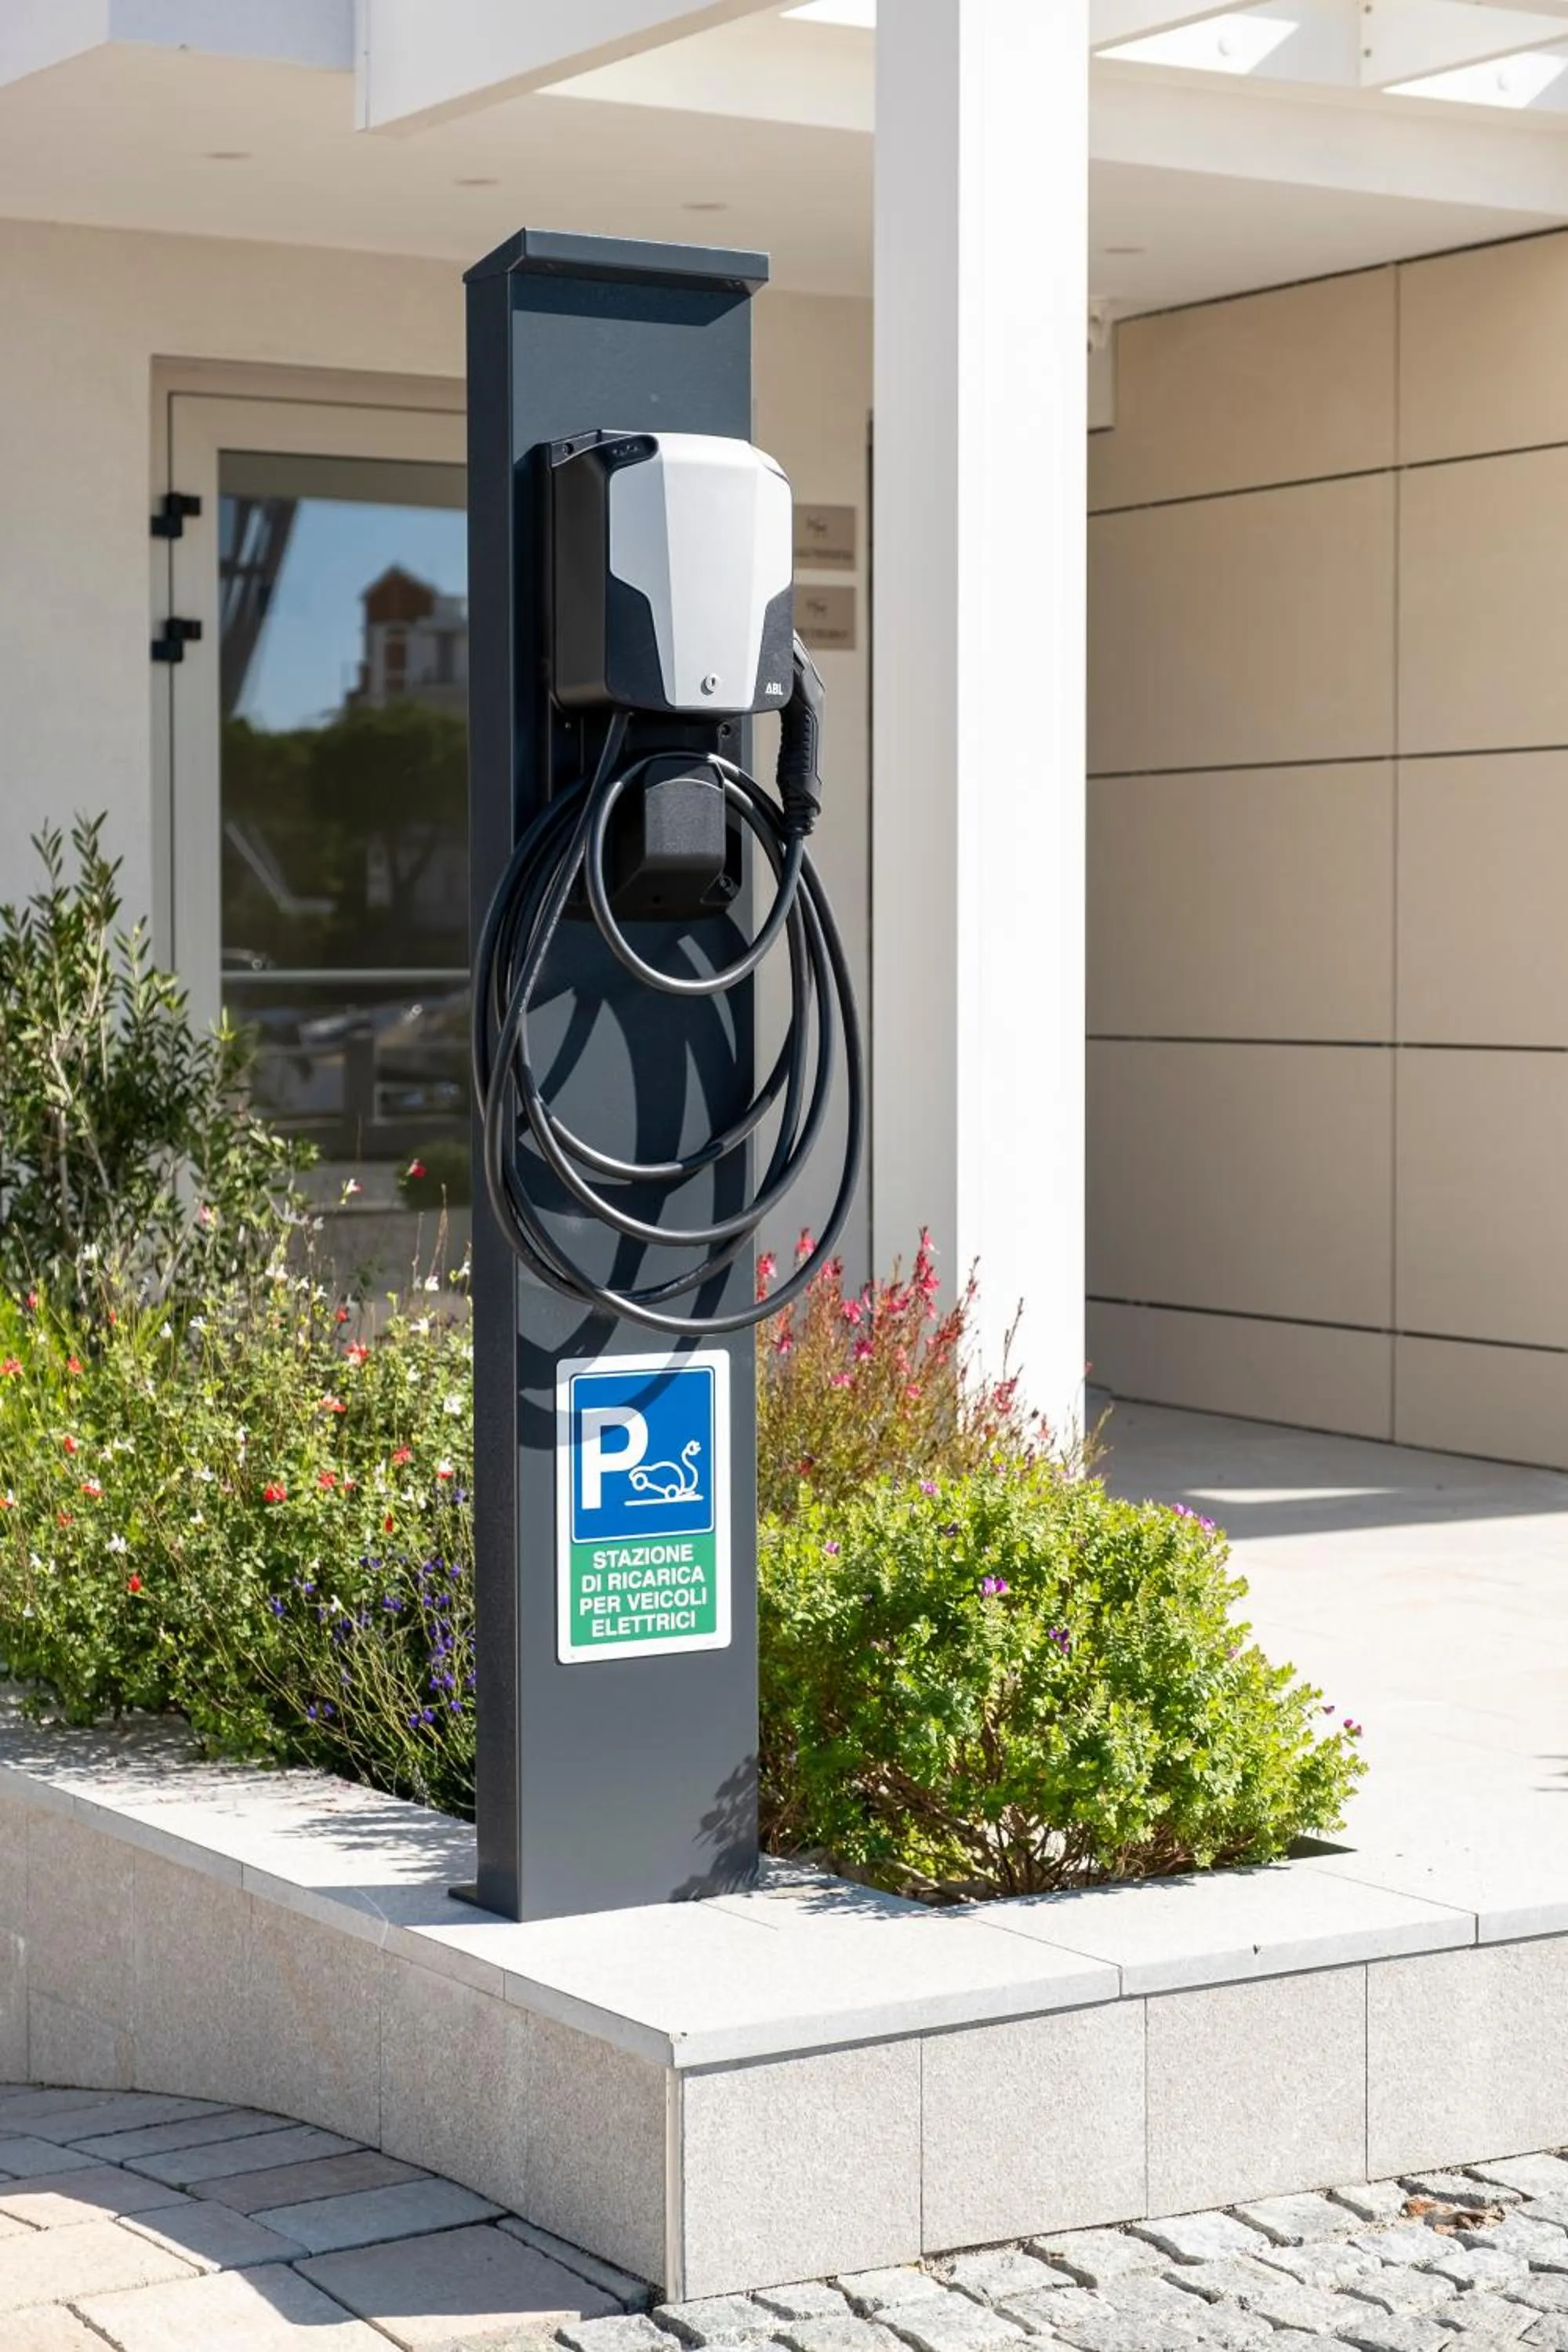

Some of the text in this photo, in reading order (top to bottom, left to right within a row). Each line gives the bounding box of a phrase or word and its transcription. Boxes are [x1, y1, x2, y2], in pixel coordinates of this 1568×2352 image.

[765, 682, 783, 695] ABL
[581, 1405, 649, 1510] P
[593, 1544, 694, 1570] STAZIONE
[582, 1565, 705, 1593] DI RICARICA
[579, 1587, 707, 1616] PER VEICOLI
[592, 1610, 695, 1637] ELETTRICI
